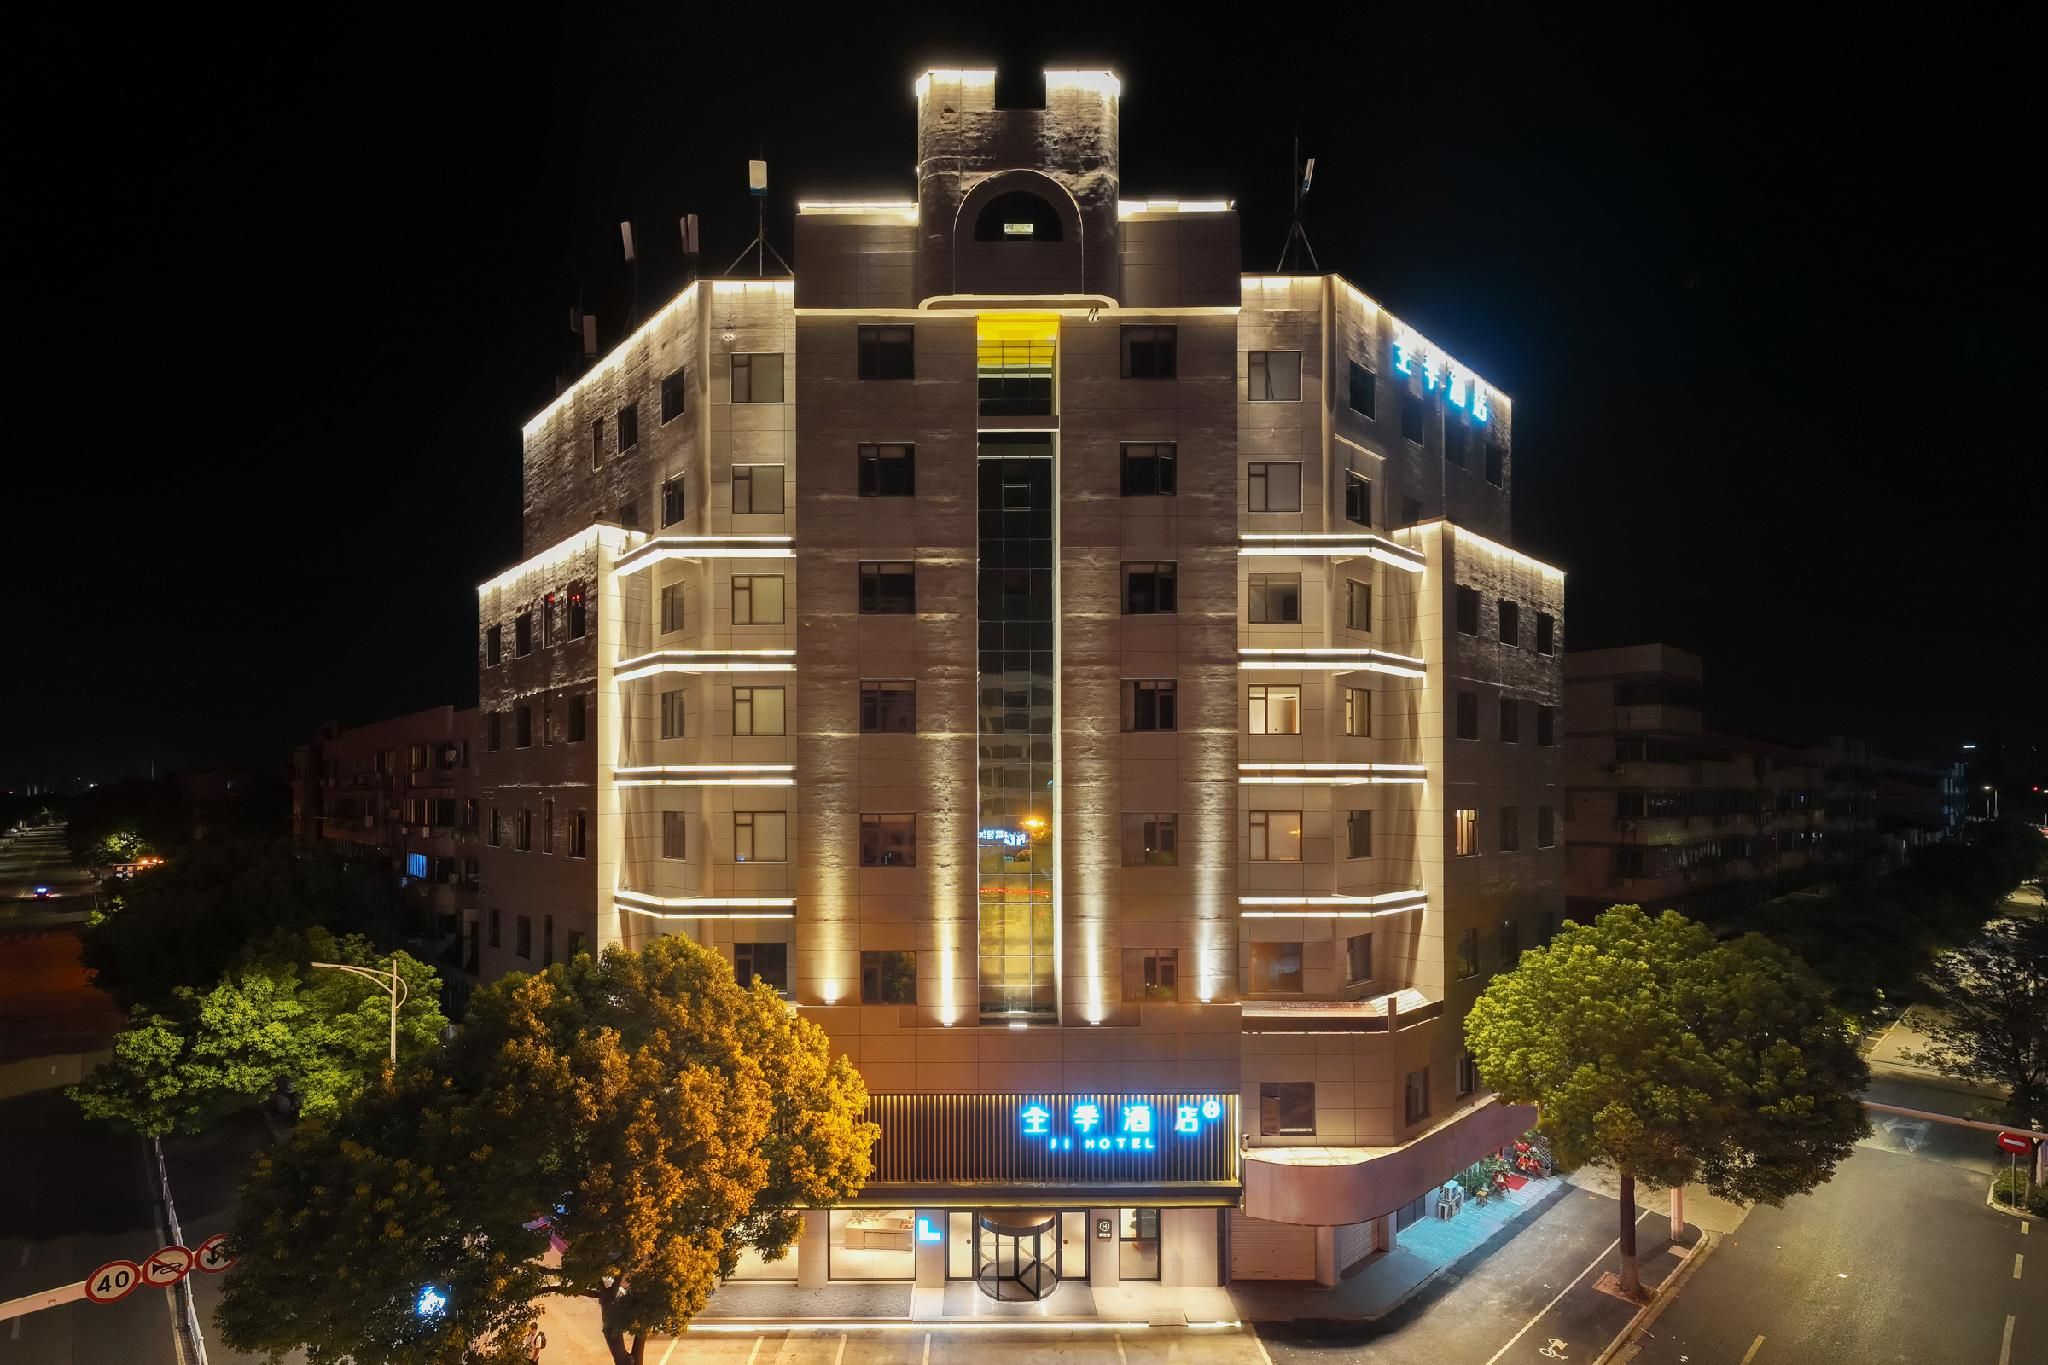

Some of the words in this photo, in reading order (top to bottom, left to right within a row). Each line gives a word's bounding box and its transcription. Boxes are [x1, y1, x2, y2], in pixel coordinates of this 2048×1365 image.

[1022, 1104, 1199, 1132] 全季酒店
[1085, 1138, 1155, 1149] HOTEL
[97, 1271, 129, 1292] 40
